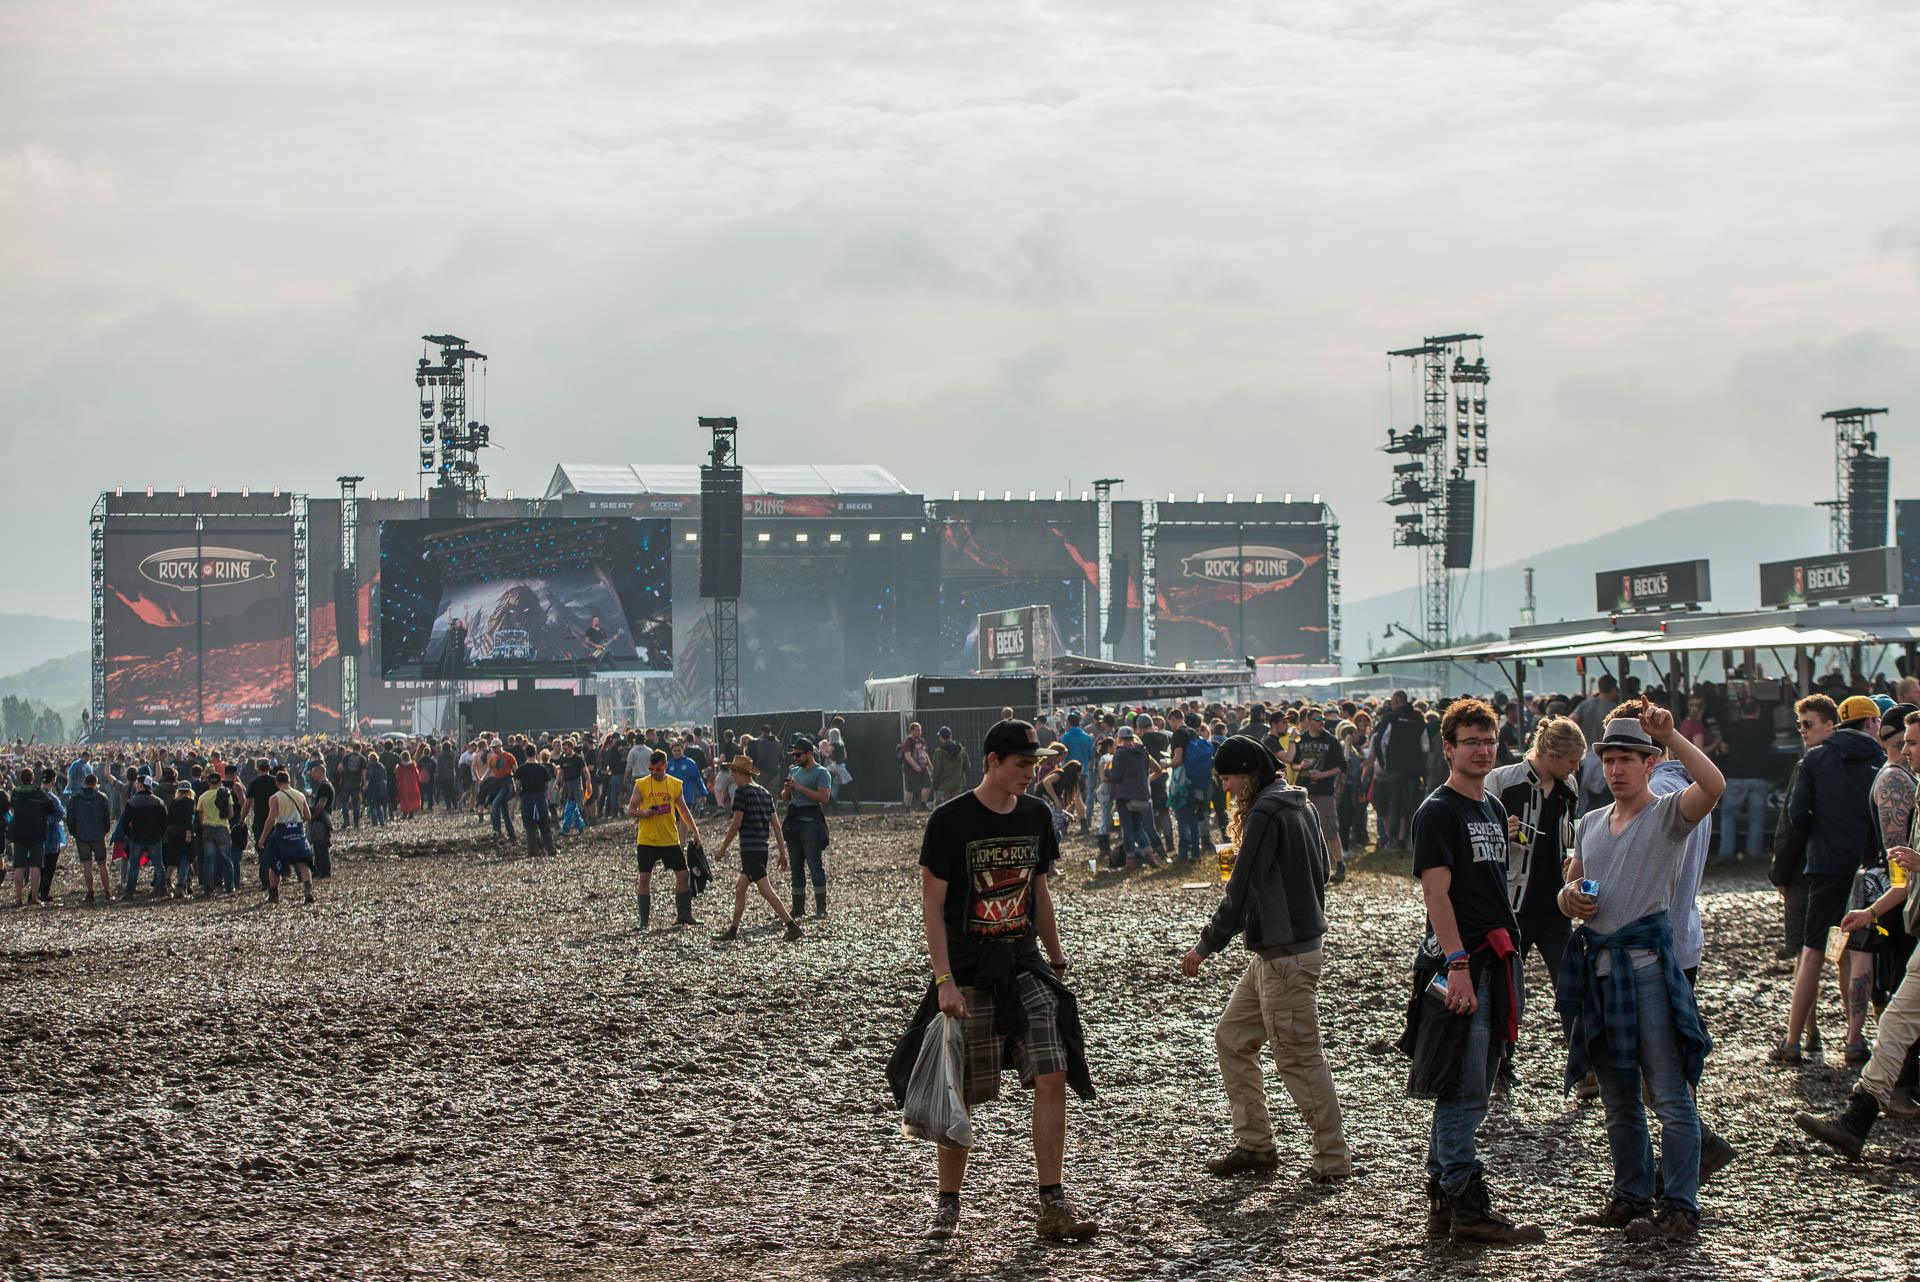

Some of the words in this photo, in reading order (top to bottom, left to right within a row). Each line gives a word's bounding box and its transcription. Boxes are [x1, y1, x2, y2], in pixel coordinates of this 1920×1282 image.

[754, 500, 784, 514] RING
[159, 562, 199, 579] ROCK
[215, 561, 251, 578] RING
[1204, 560, 1240, 577] ROCK
[1255, 560, 1289, 577] RING
[1806, 563, 1851, 590] BECK'S
[1633, 574, 1669, 597] BECK'S
[996, 627, 1025, 655] BECK'S
[396, 681, 434, 689] SEAT
[1011, 847, 1036, 860] ROCK
